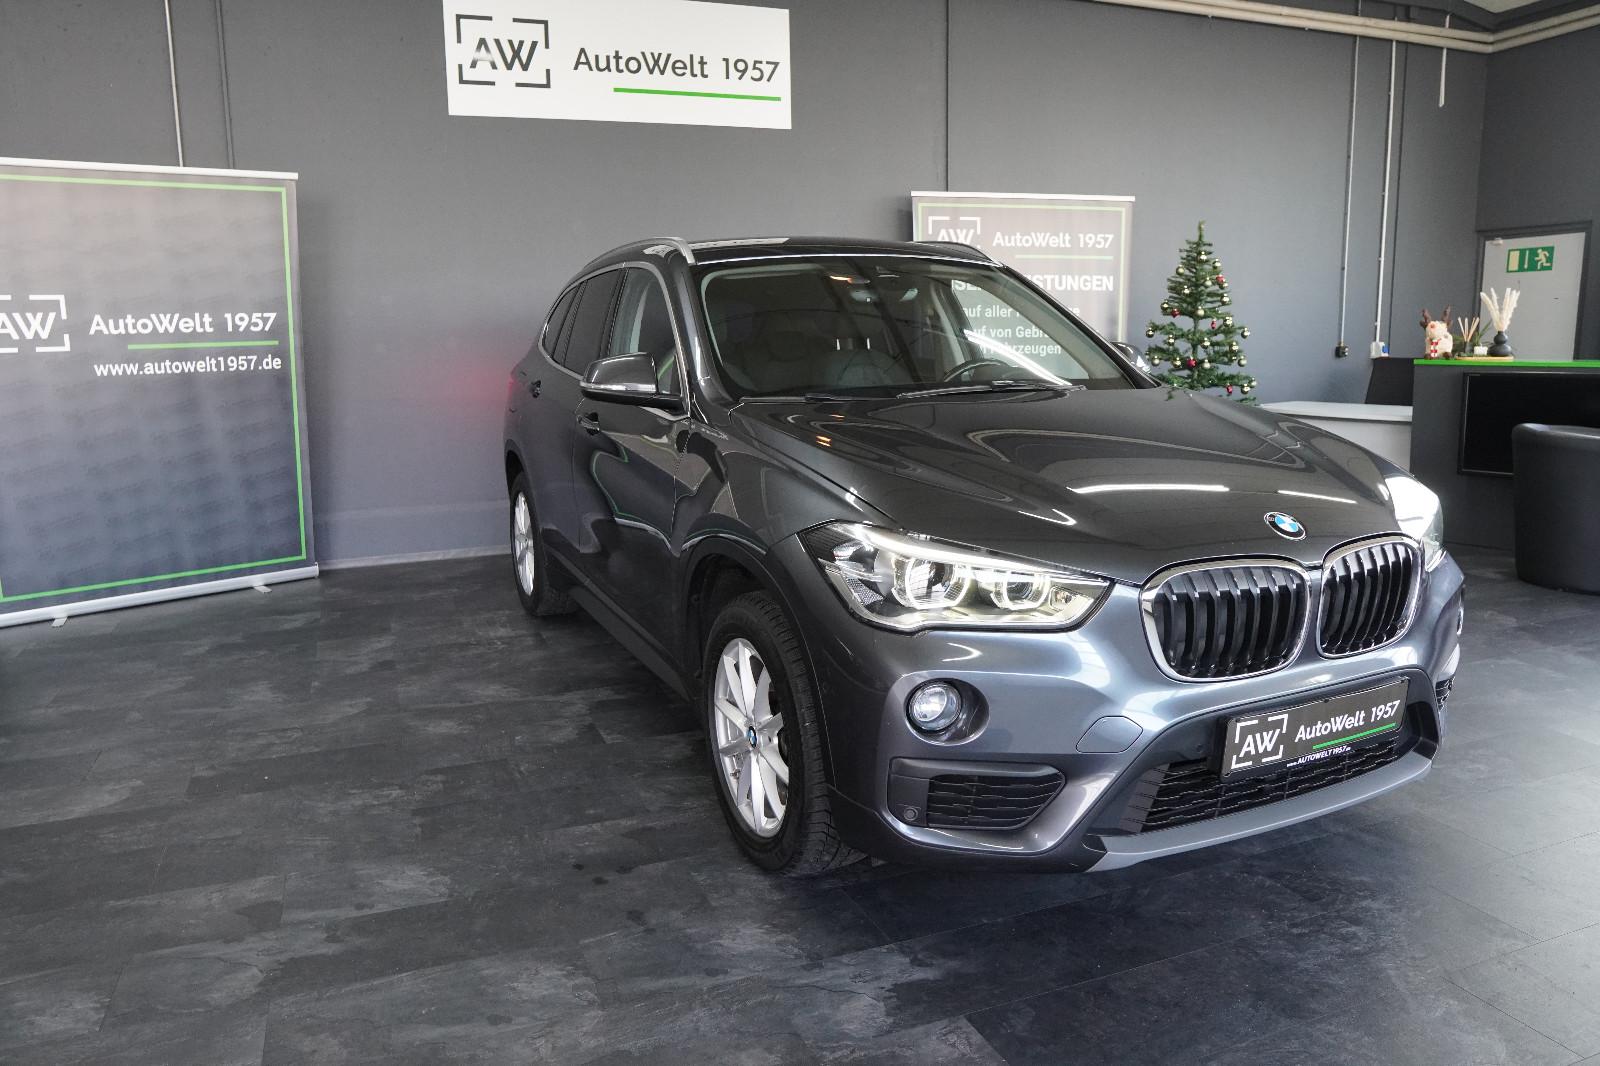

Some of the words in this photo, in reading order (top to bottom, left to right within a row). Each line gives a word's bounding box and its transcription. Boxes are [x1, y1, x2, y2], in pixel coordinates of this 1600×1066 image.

[469, 37, 538, 72] AW
[573, 47, 708, 79] AutoWelt
[722, 57, 780, 83] 1957
[992, 231, 1071, 248] AutoWelt
[1078, 233, 1114, 249] 1957
[1030, 275, 1114, 291] STUNGEN
[985, 305, 1013, 317] aller
[0, 312, 56, 340] AW
[89, 312, 214, 335] AutoWelt
[224, 312, 277, 332] 1957
[990, 328, 1011, 338] von
[94, 354, 282, 376] www.autowelt1957.de
[1294, 710, 1365, 743] AutoWelt
[1370, 699, 1401, 723] 1957
[1239, 728, 1280, 758] AW
